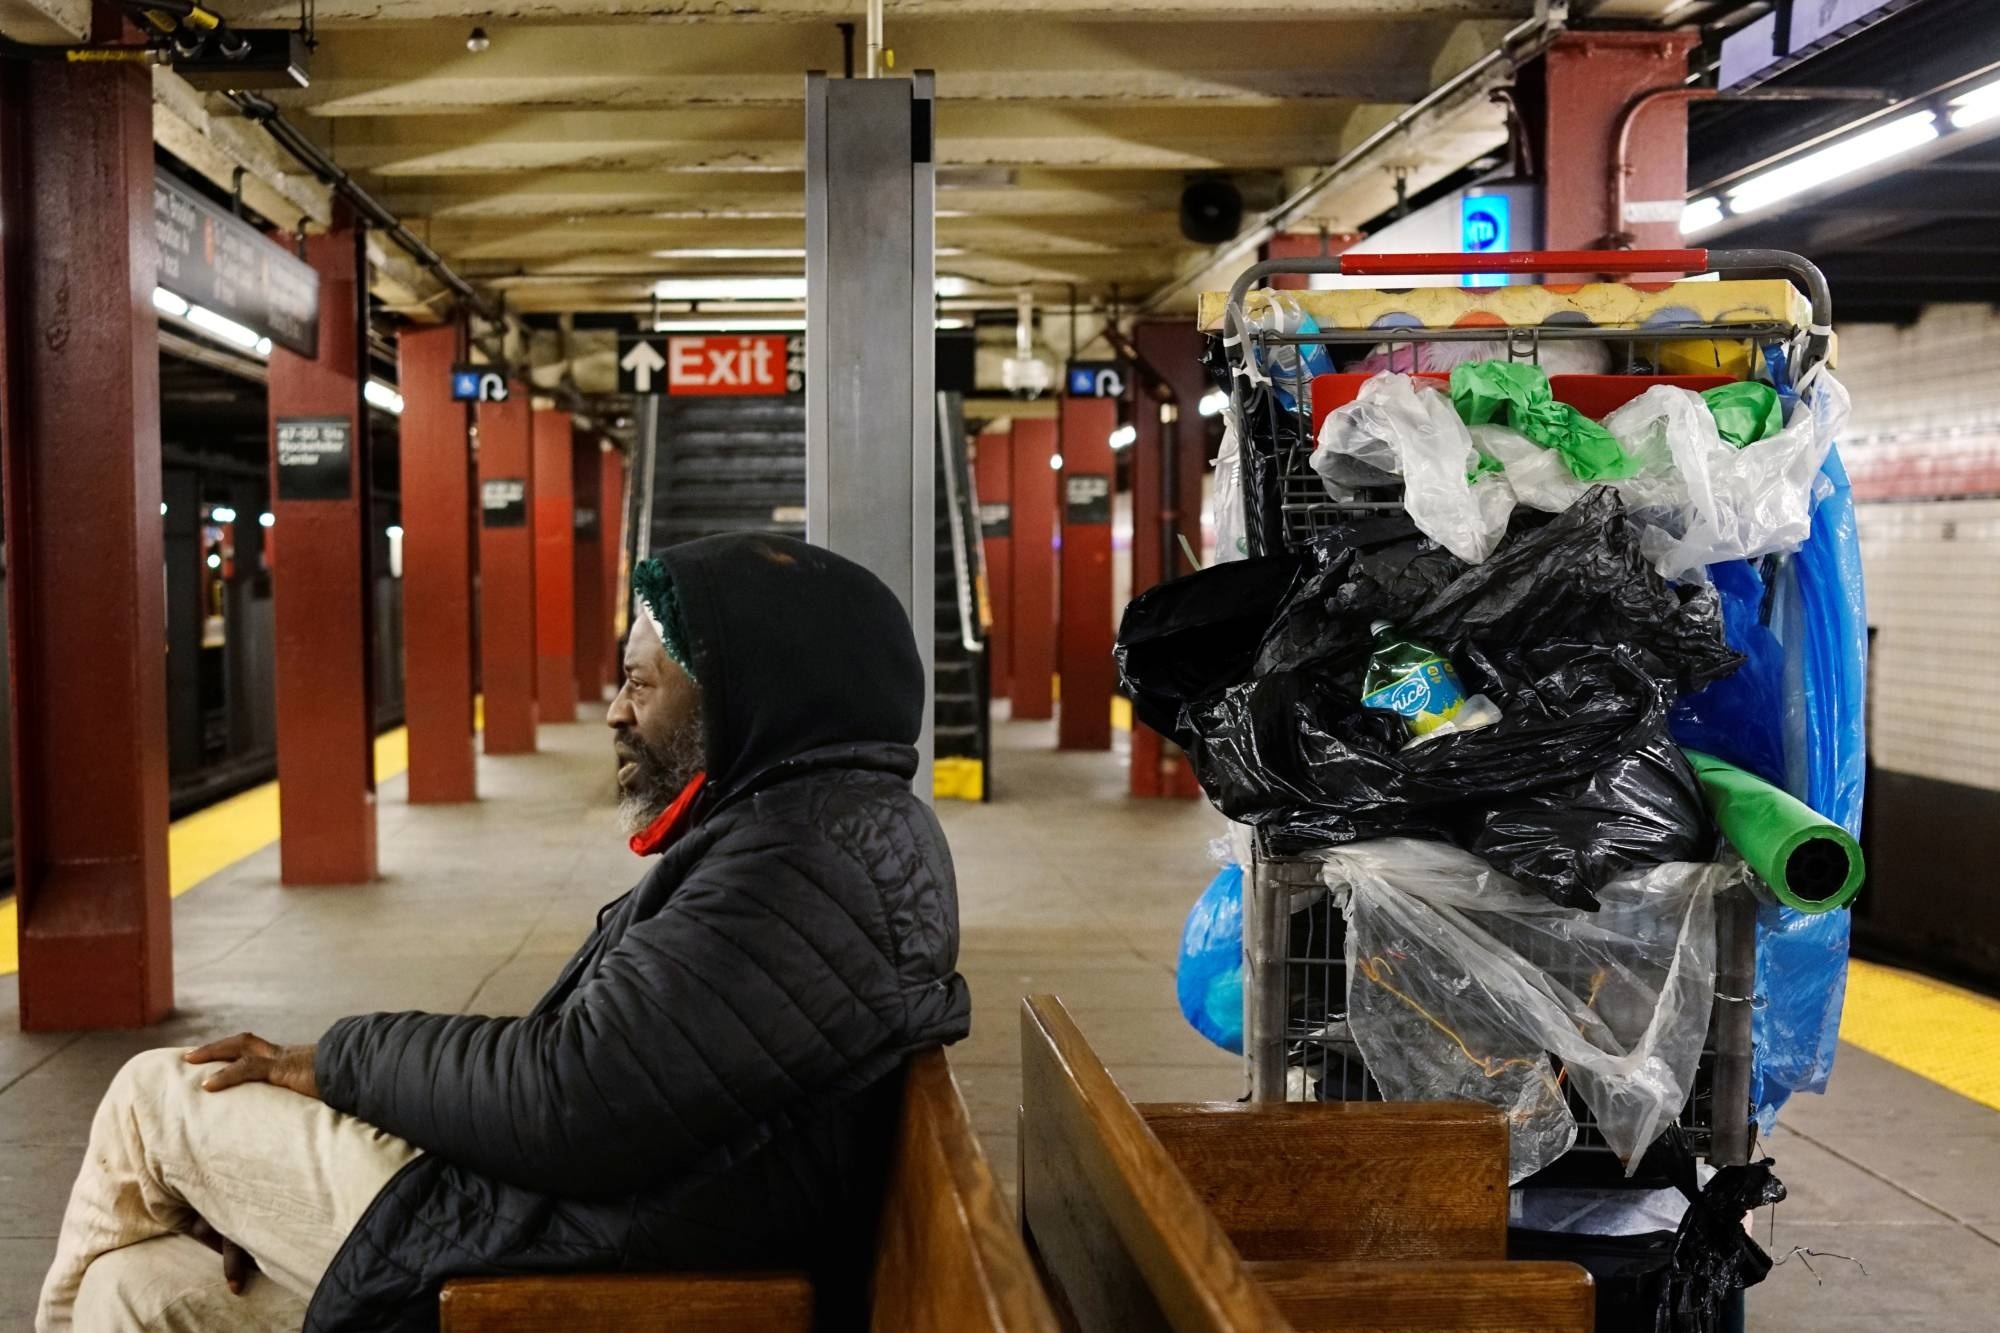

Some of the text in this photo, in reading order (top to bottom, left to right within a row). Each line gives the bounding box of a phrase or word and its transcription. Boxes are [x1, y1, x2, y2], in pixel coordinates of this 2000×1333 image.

[669, 337, 775, 385] Exit
[279, 454, 320, 466] Center
[1392, 683, 1427, 711] nice
